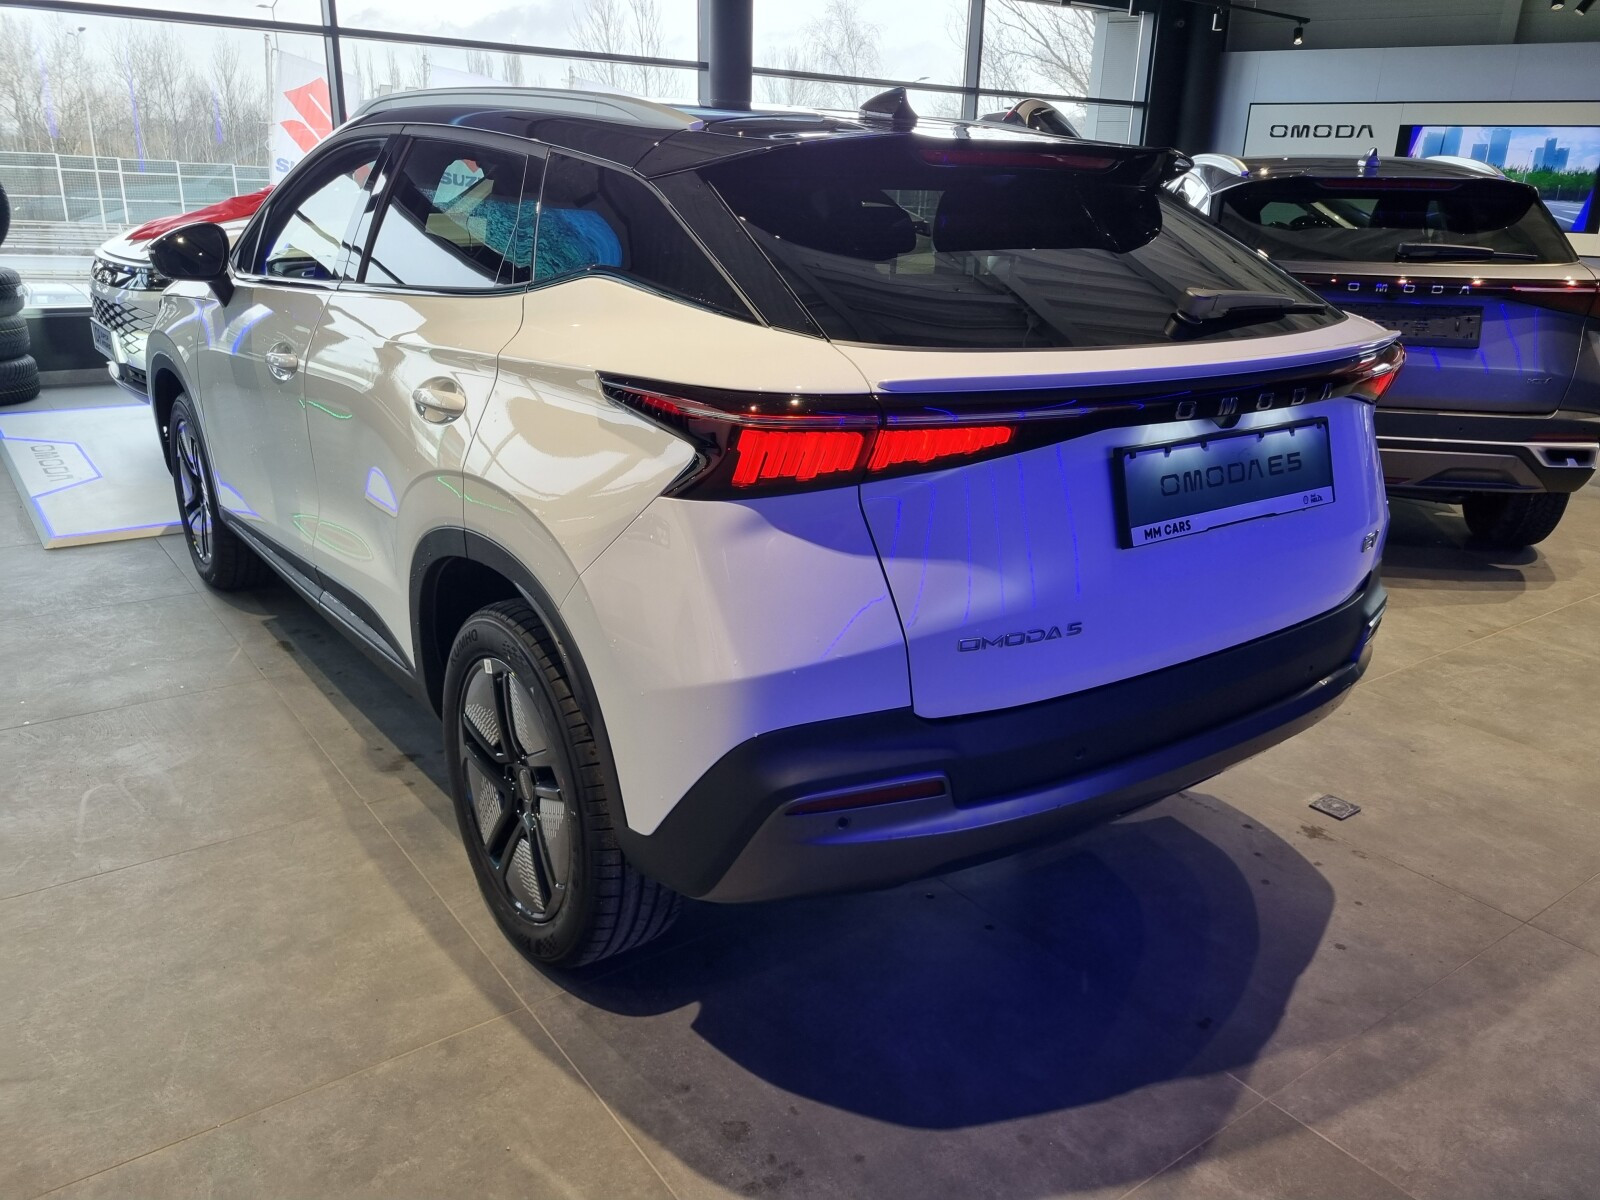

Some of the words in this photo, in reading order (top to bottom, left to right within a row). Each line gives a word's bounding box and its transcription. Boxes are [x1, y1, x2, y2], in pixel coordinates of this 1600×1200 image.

[1269, 124, 1374, 138] OMODA
[1347, 282, 1471, 295] OMODA
[1174, 382, 1334, 420] OMODA
[30, 445, 74, 482] OMODA
[1144, 526, 1162, 541] MM
[1164, 519, 1192, 537] CARS
[957, 626, 1063, 652] OMODA
[1066, 622, 1083, 637] 5
